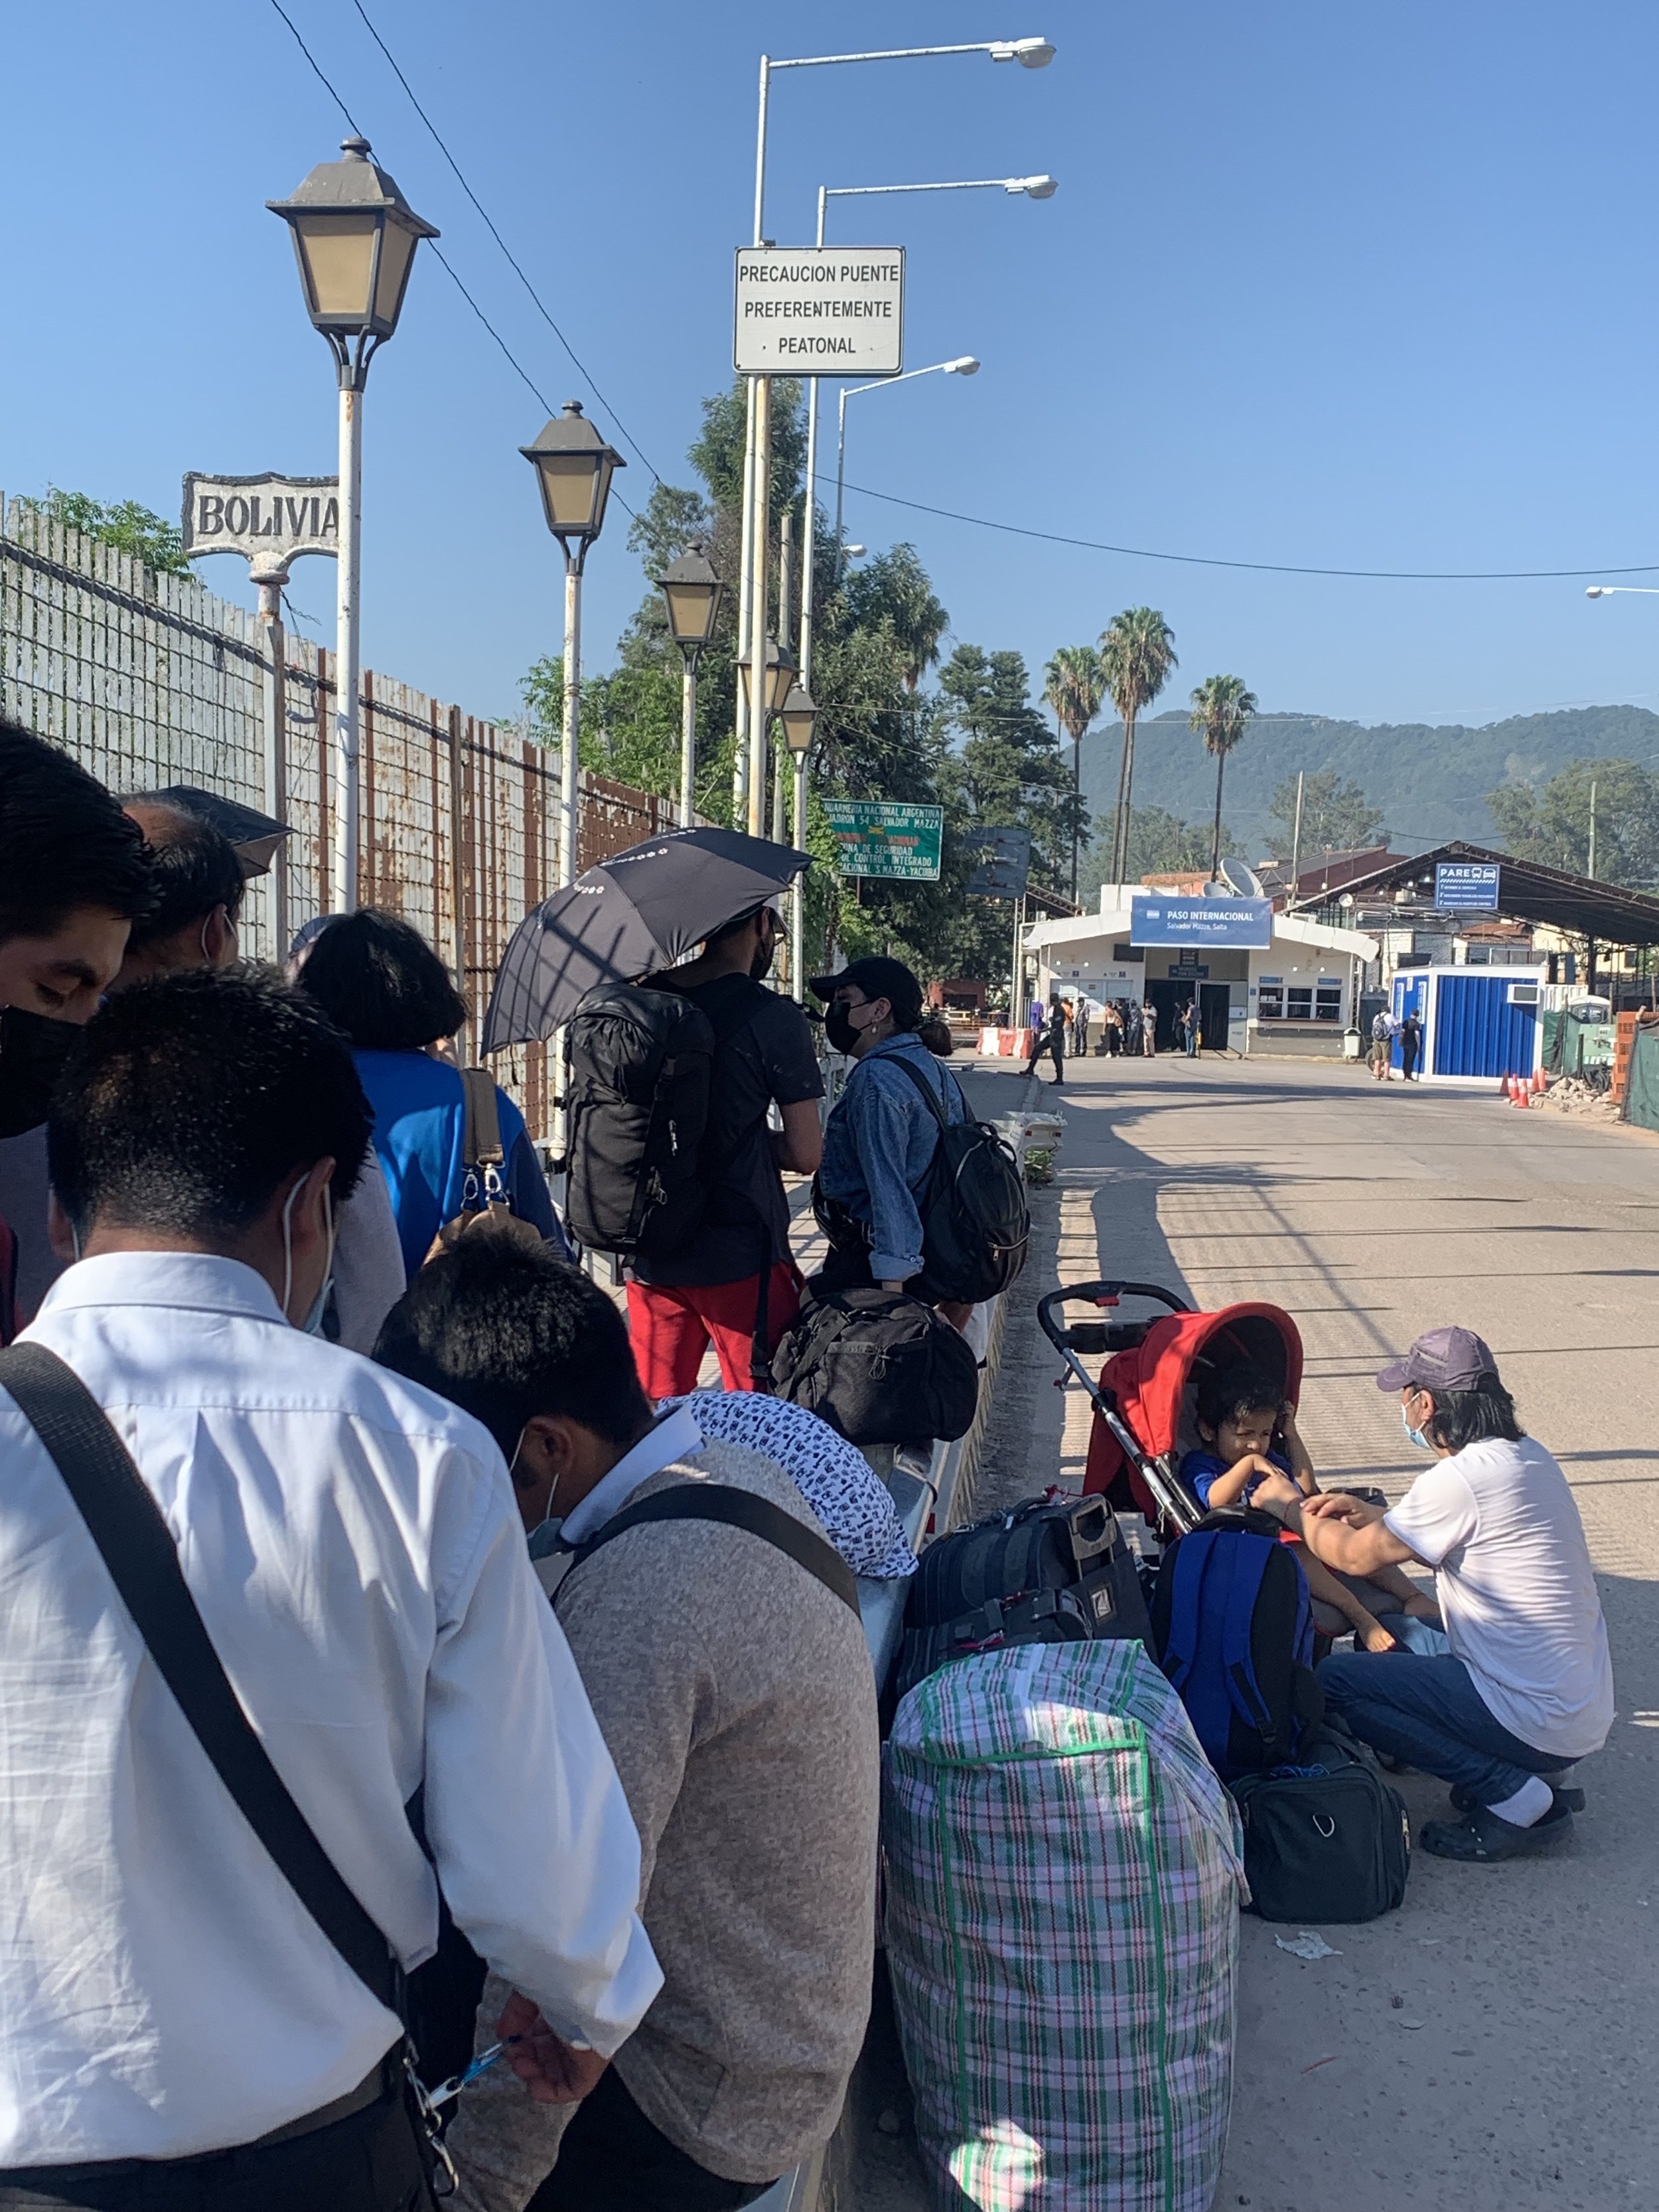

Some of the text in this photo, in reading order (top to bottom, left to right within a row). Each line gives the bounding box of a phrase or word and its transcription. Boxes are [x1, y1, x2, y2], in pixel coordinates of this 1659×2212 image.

[740, 265, 899, 282] PRECAUCION PUENTE
[745, 301, 892, 318] PREFERENTEMENTE
[778, 337, 856, 353] PEATONAL
[199, 495, 338, 536] BOLIVIA
[864, 804, 899, 816] NACIONAL
[901, 807, 940, 819] ARGENTINA
[859, 815, 869, 825] 54
[874, 817, 909, 828] SALVADOR
[914, 819, 940, 829] MAZZA
[863, 844, 872, 854] DE
[875, 844, 913, 856] SEGURIDAD
[854, 853, 887, 864] CONTROL
[891, 855, 932, 867] INTEGRADO
[1440, 868, 1471, 877] PARE
[1167, 911, 1254, 921] PASO INTERNACIONAL
